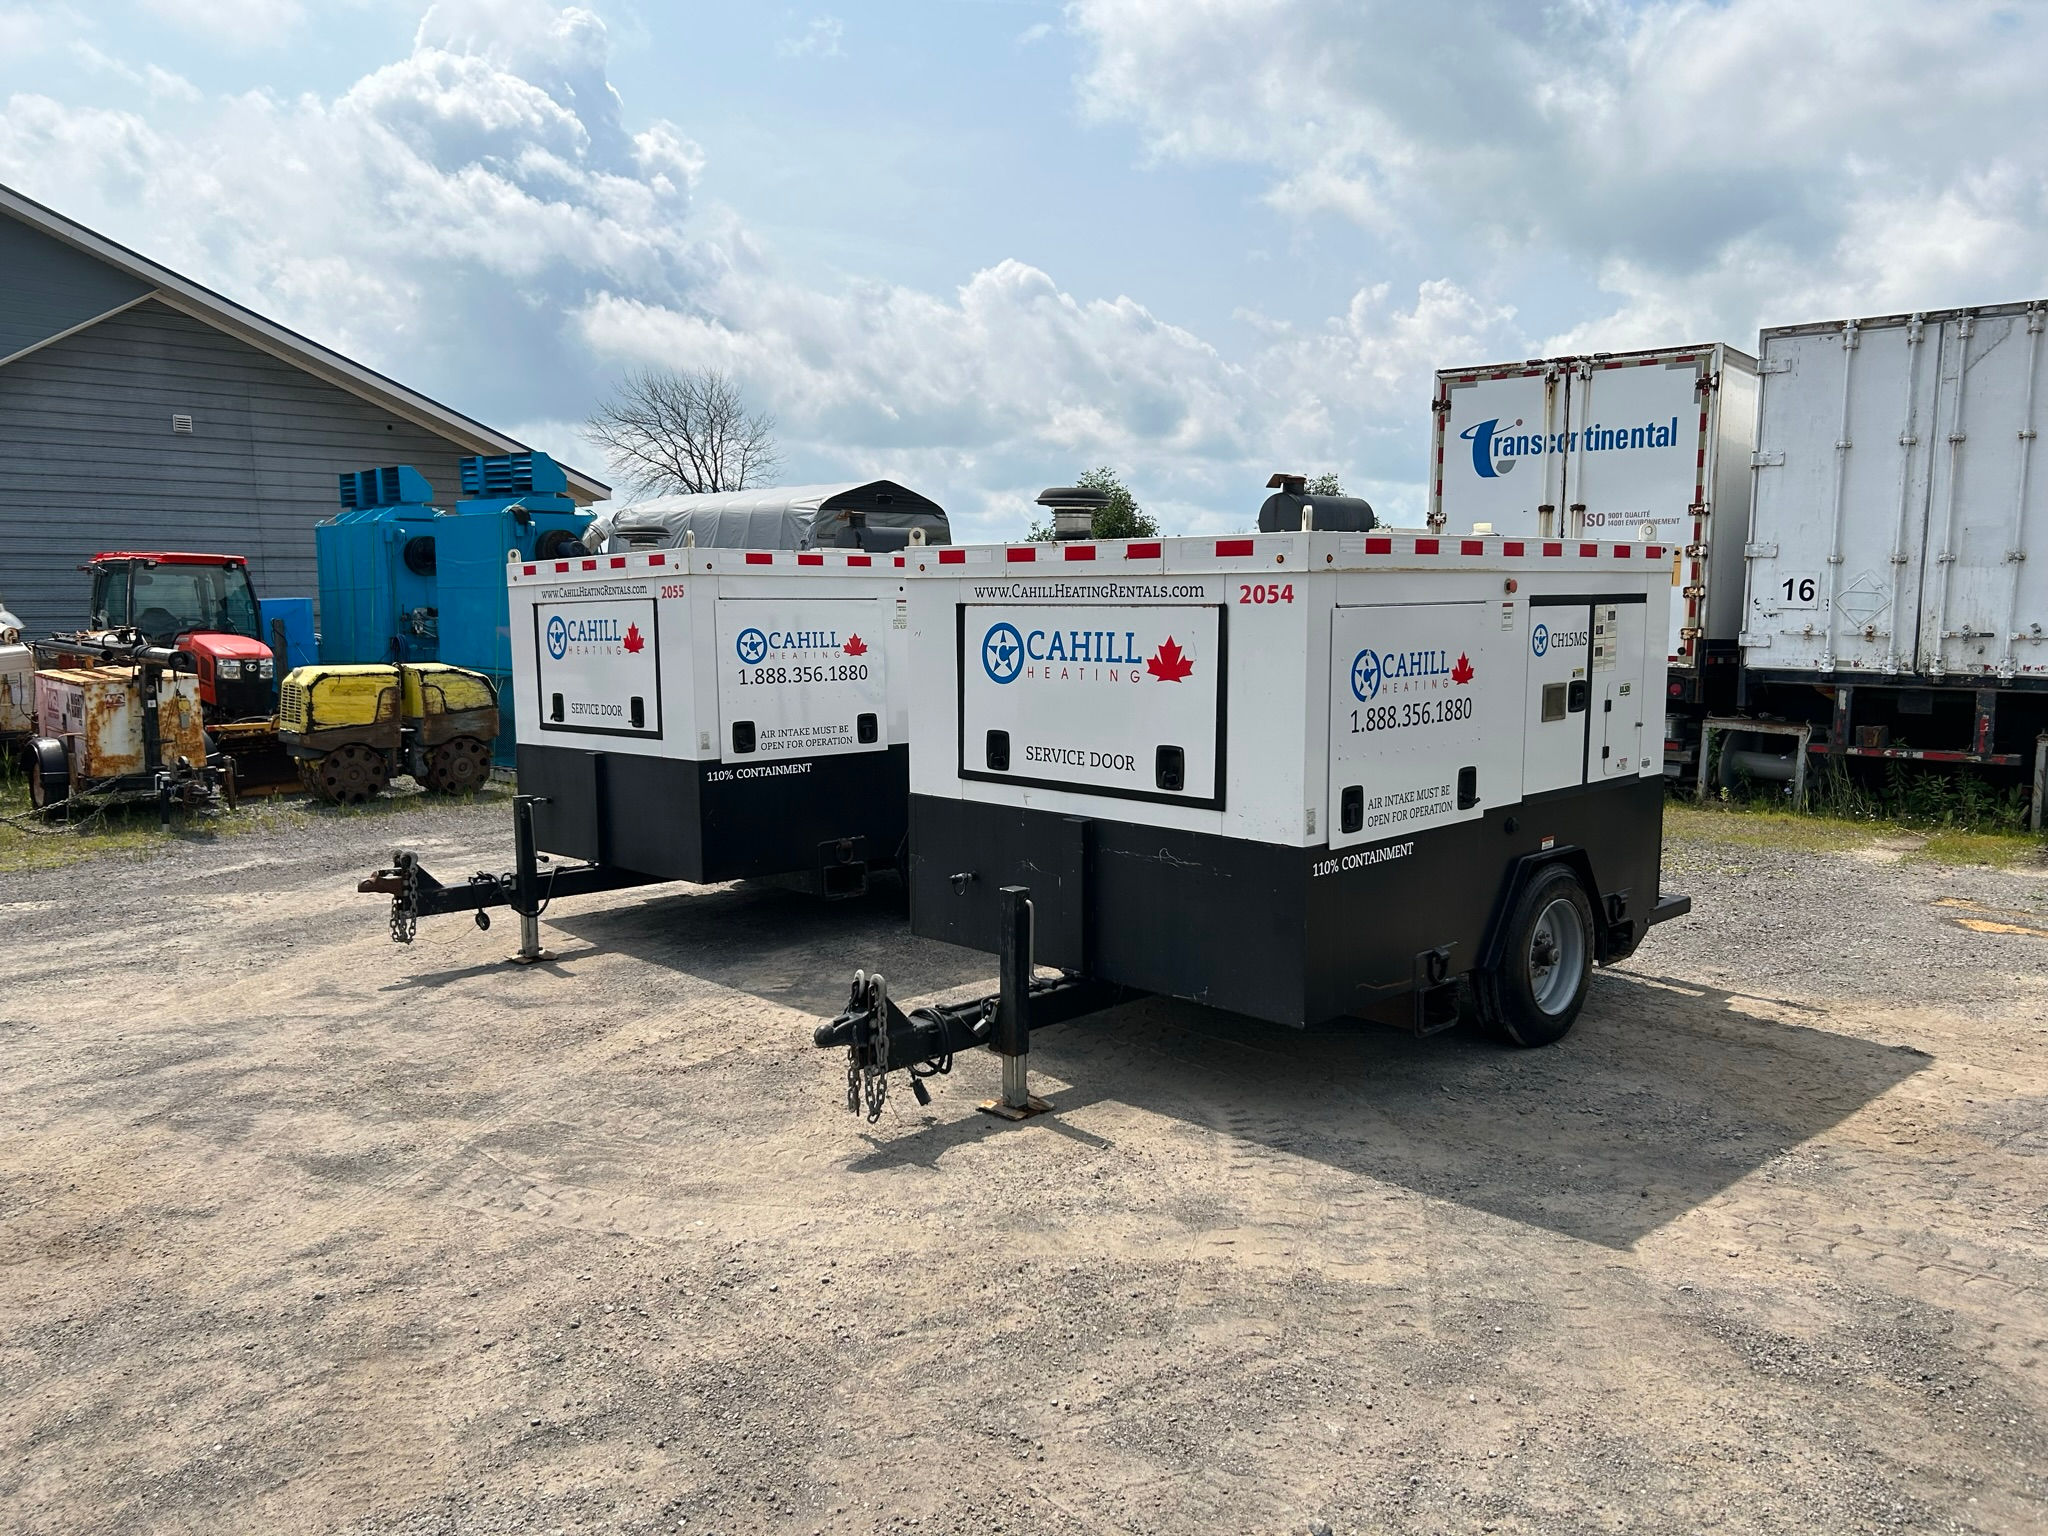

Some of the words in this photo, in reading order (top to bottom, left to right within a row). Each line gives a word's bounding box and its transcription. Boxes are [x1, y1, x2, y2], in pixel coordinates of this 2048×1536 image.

[1582, 513, 1606, 528] ISO
[661, 585, 685, 599] 2055
[1239, 583, 1294, 604] 2054
[1782, 578, 1815, 601] 16
[567, 619, 622, 642] CAHILL
[768, 631, 841, 649] CAHILL
[1551, 631, 1588, 648] CH15MS
[568, 645, 622, 656] HEATING
[769, 650, 840, 660] HEATING
[1026, 630, 1142, 664] CAHILL
[1382, 650, 1450, 678] CAHILL
[738, 664, 868, 685] 1.888.356.1880
[1027, 666, 1141, 683] HEATING
[1382, 678, 1449, 694] HEATING
[571, 702, 600, 715] SERVICE
[600, 704, 623, 717] DOOR
[1350, 697, 1472, 734] 1.888.356.1880
[760, 729, 776, 738] AIR
[778, 727, 810, 737] INTAKE
[812, 726, 837, 735] MUST
[838, 725, 849, 733] BE
[760, 740, 785, 751] OPEN
[786, 738, 804, 748] FOR
[805, 735, 853, 747] OPERATION
[1026, 745, 1085, 766] SERVICE
[1090, 752, 1136, 772] DOOR
[707, 770, 734, 782] 110%
[736, 763, 812, 779] CONTAINMENT
[1367, 798, 1383, 810] AIR
[1384, 791, 1415, 807] INTAKE
[1416, 787, 1440, 800] MUST
[1440, 784, 1451, 796] BE
[1367, 813, 1390, 828] OPEN
[1392, 809, 1408, 823] FOR
[1409, 800, 1454, 819] OPERATION
[1312, 858, 1340, 877] 110%
[1341, 842, 1415, 871] CONTAINMENT
